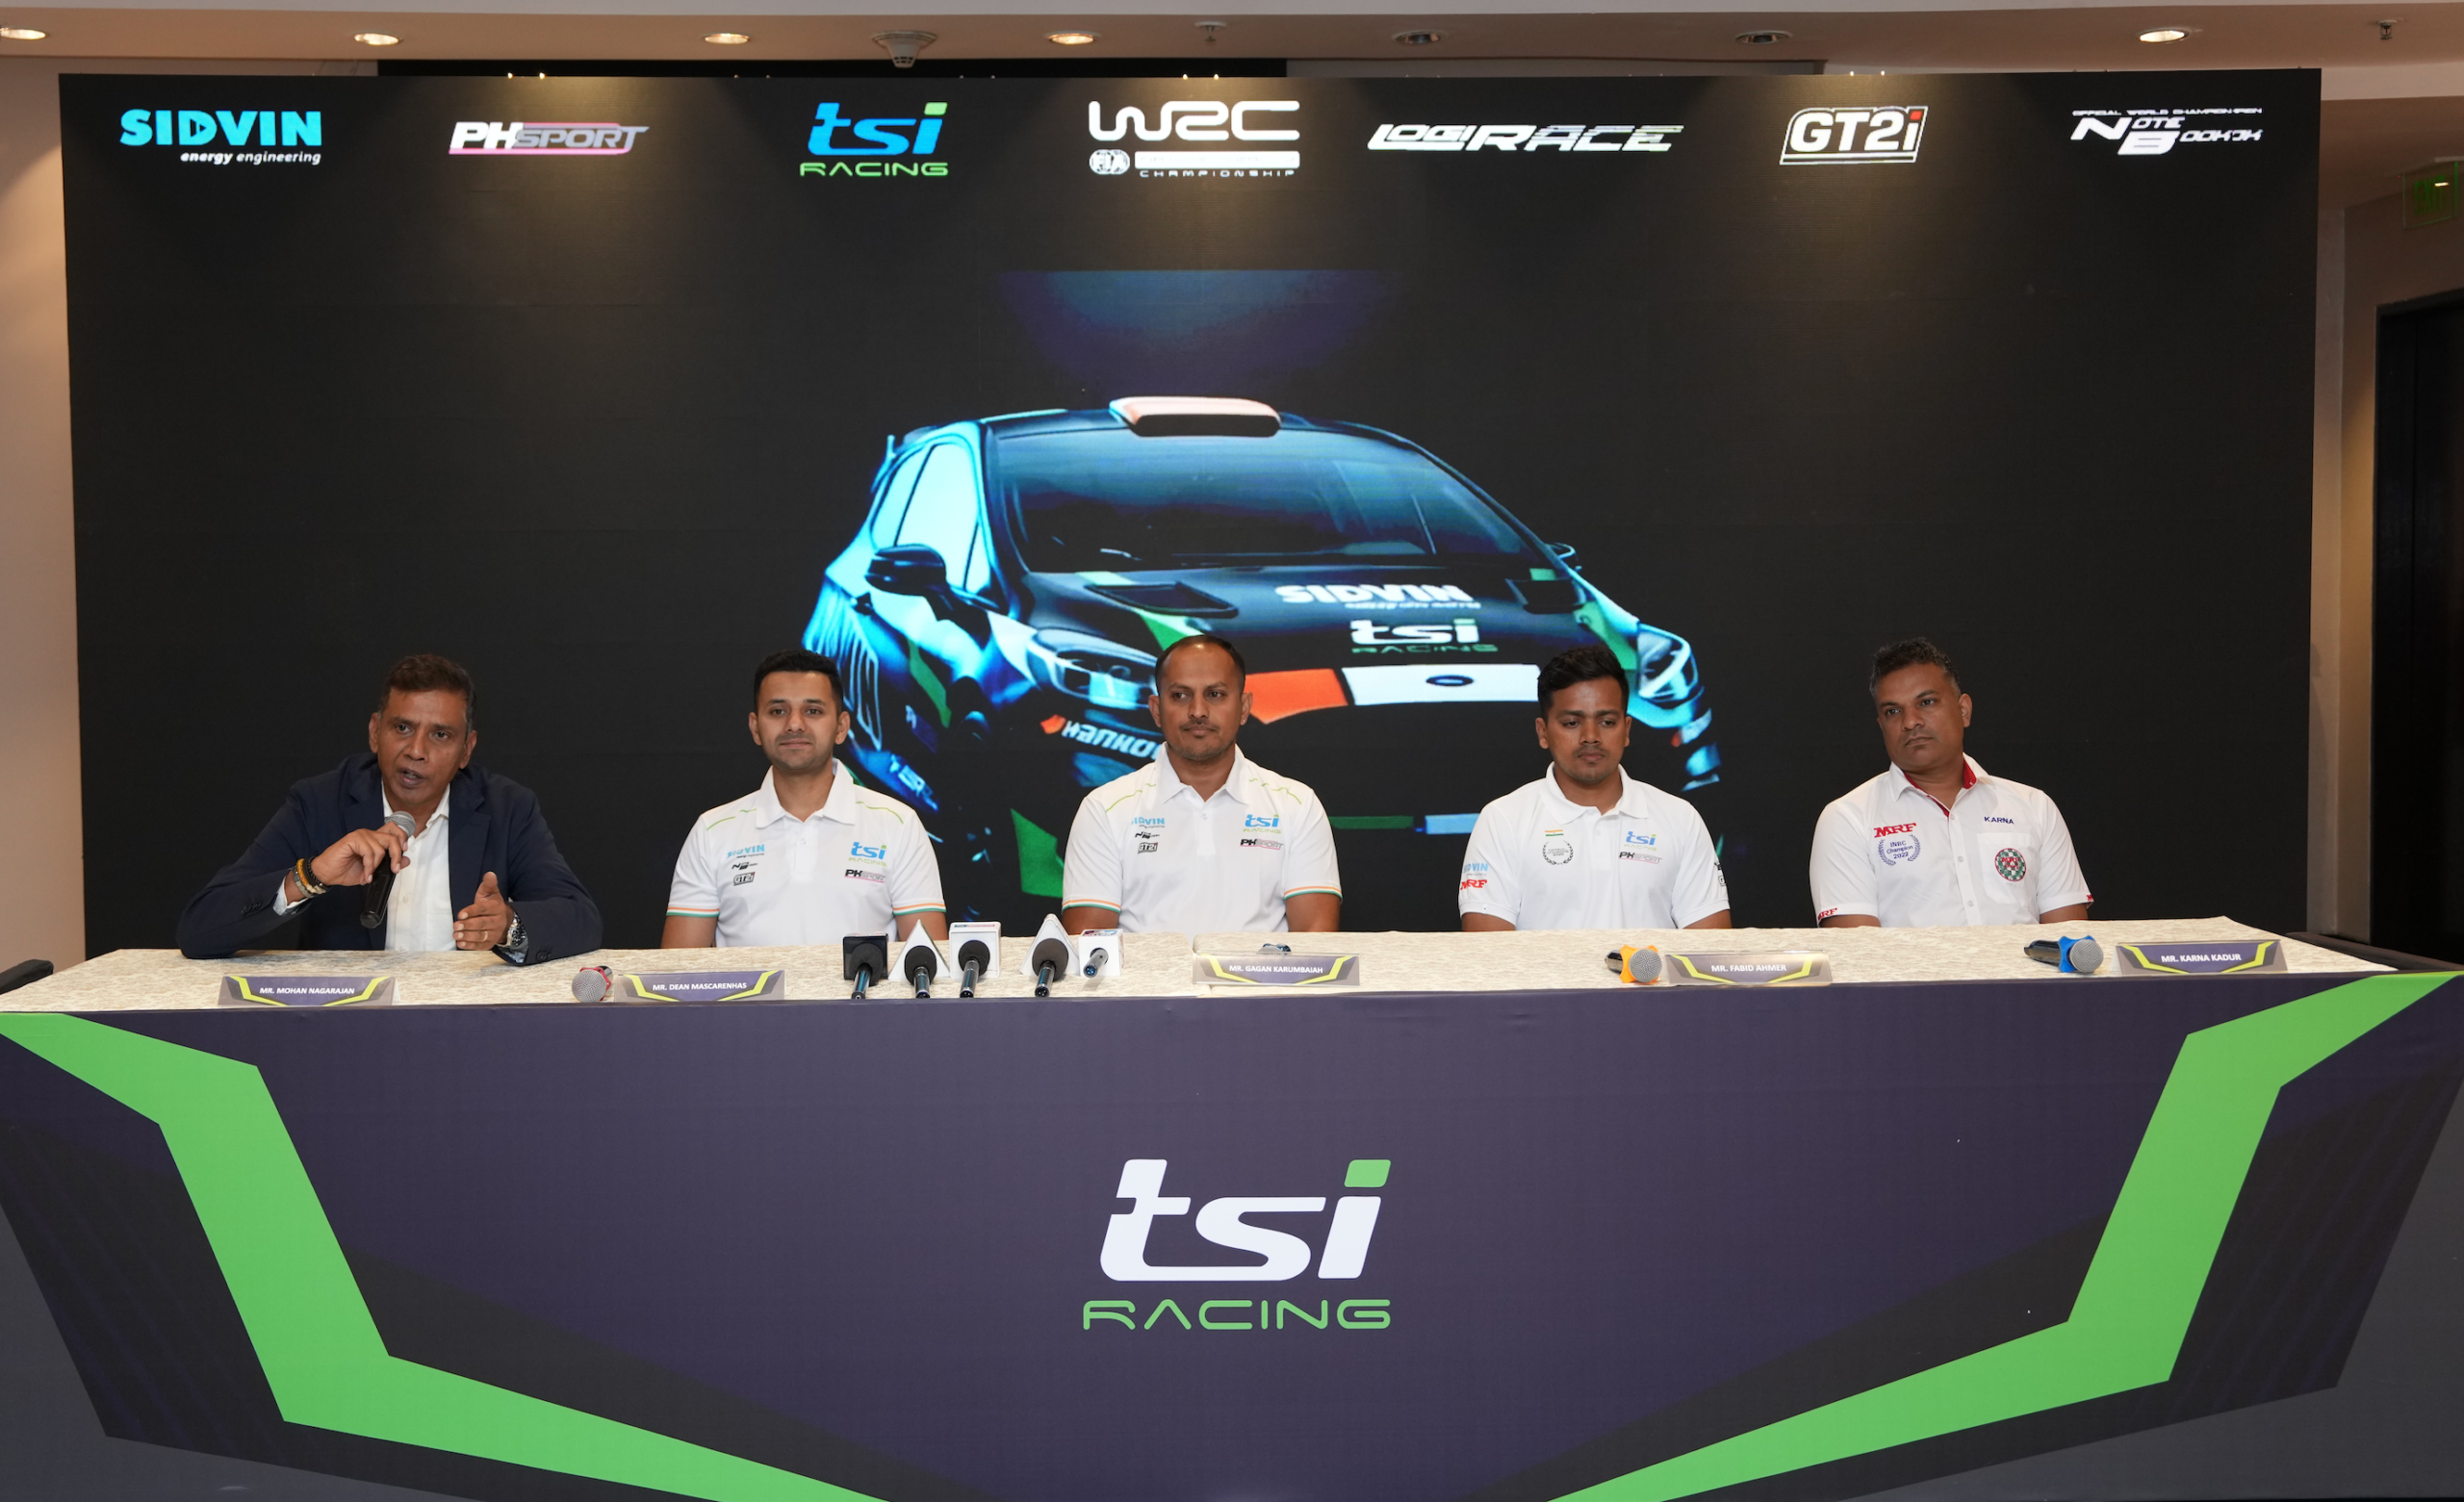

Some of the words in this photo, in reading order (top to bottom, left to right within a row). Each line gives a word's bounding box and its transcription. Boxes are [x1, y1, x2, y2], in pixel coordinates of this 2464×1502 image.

[119, 109, 321, 146] SIDVIN
[1089, 100, 1300, 141] WRC
[808, 102, 948, 156] tsi
[180, 152, 233, 165] energy
[236, 151, 321, 165] engineering
[800, 162, 948, 177] RACING
[1139, 169, 1296, 178] CHAMPIONSHIP
[1275, 584, 1474, 602] SIDVIN
[1350, 618, 1479, 645] tsi
[1245, 814, 1279, 827] tsi
[1984, 816, 2015, 825] KARNA
[1874, 823, 1917, 838] MRF
[851, 841, 886, 860] tsi
[1886, 845, 1913, 854] Champion
[2161, 955, 2179, 963] MR.
[2180, 954, 2210, 962] KARNA
[2211, 953, 2242, 962] KADUR
[1756, 964, 1787, 973] AHMER
[691, 981, 747, 991] MASCARENHAS
[1099, 1158, 1392, 1282] tsi
[1083, 1298, 1392, 1331] RACING
